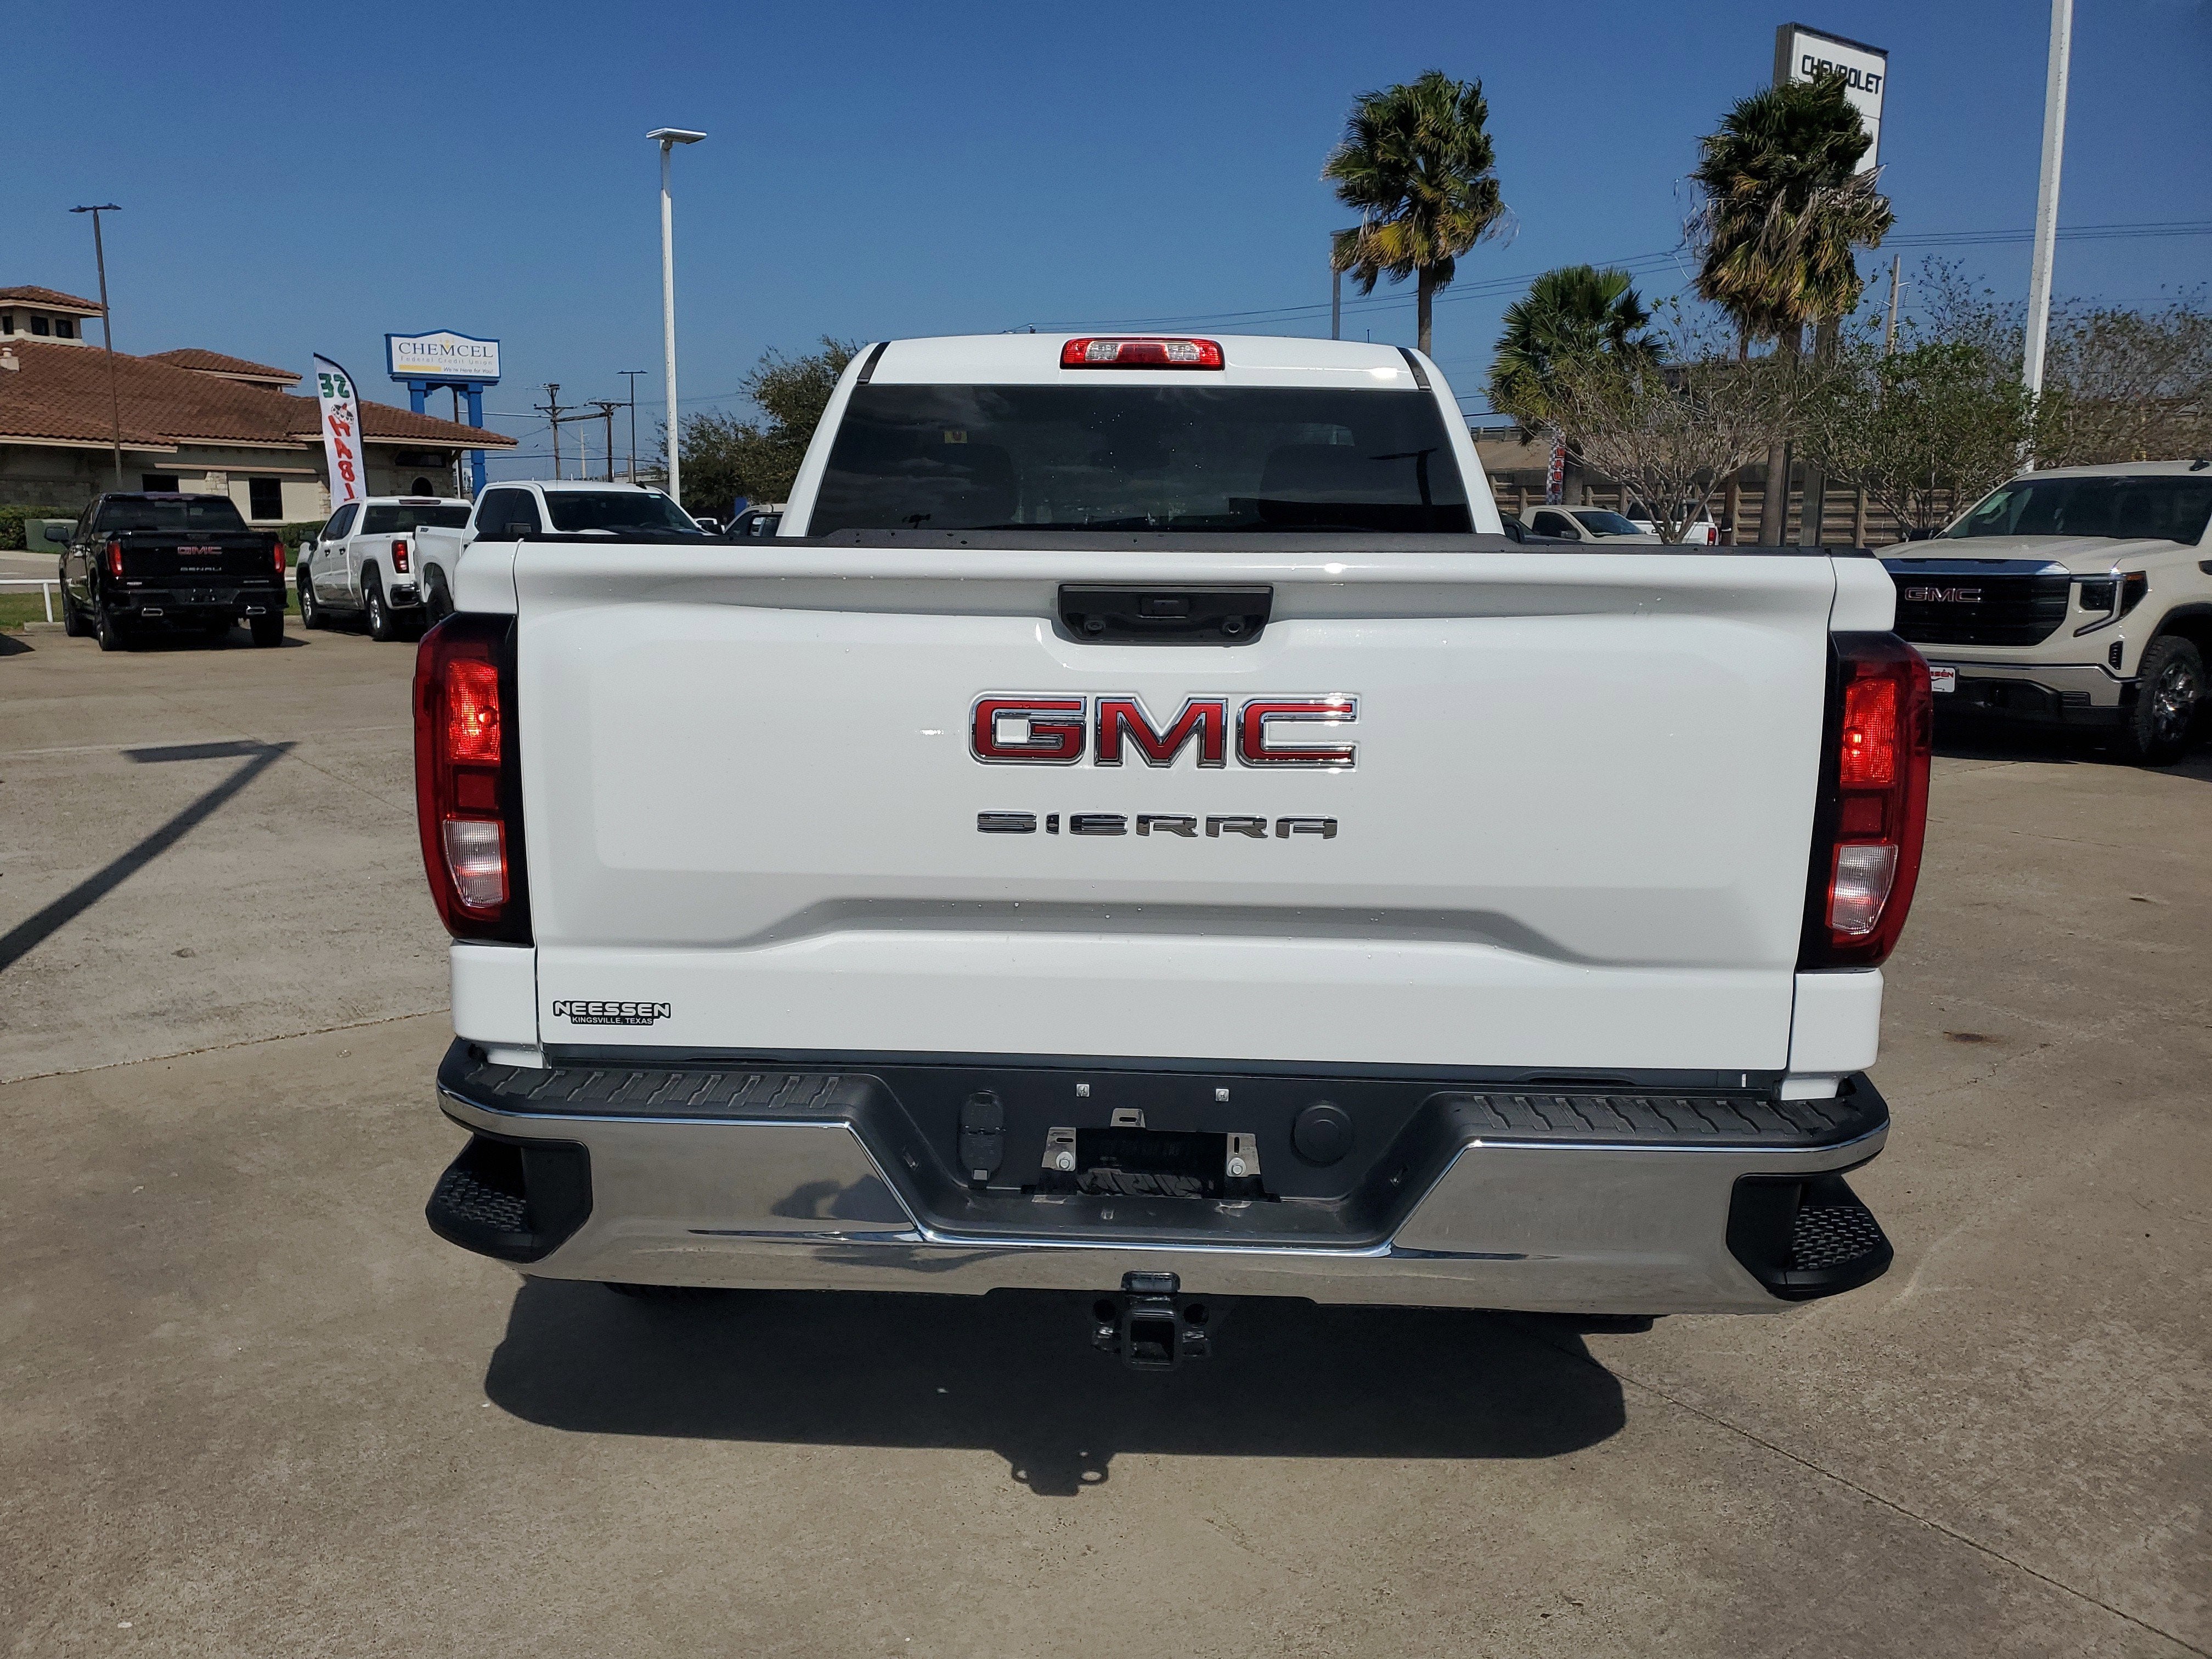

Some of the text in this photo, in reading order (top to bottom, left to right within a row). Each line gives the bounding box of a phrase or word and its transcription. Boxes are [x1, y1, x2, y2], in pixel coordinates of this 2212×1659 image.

[398, 342, 493, 358] CHEMCEL
[177, 546, 222, 555] GMC
[1905, 586, 1982, 603] GMC
[970, 694, 1357, 769] GMC
[977, 810, 1339, 839] SIERRA
[554, 1001, 670, 1018] NEESSEN
[572, 1016, 624, 1024] KINGSVILLE,
